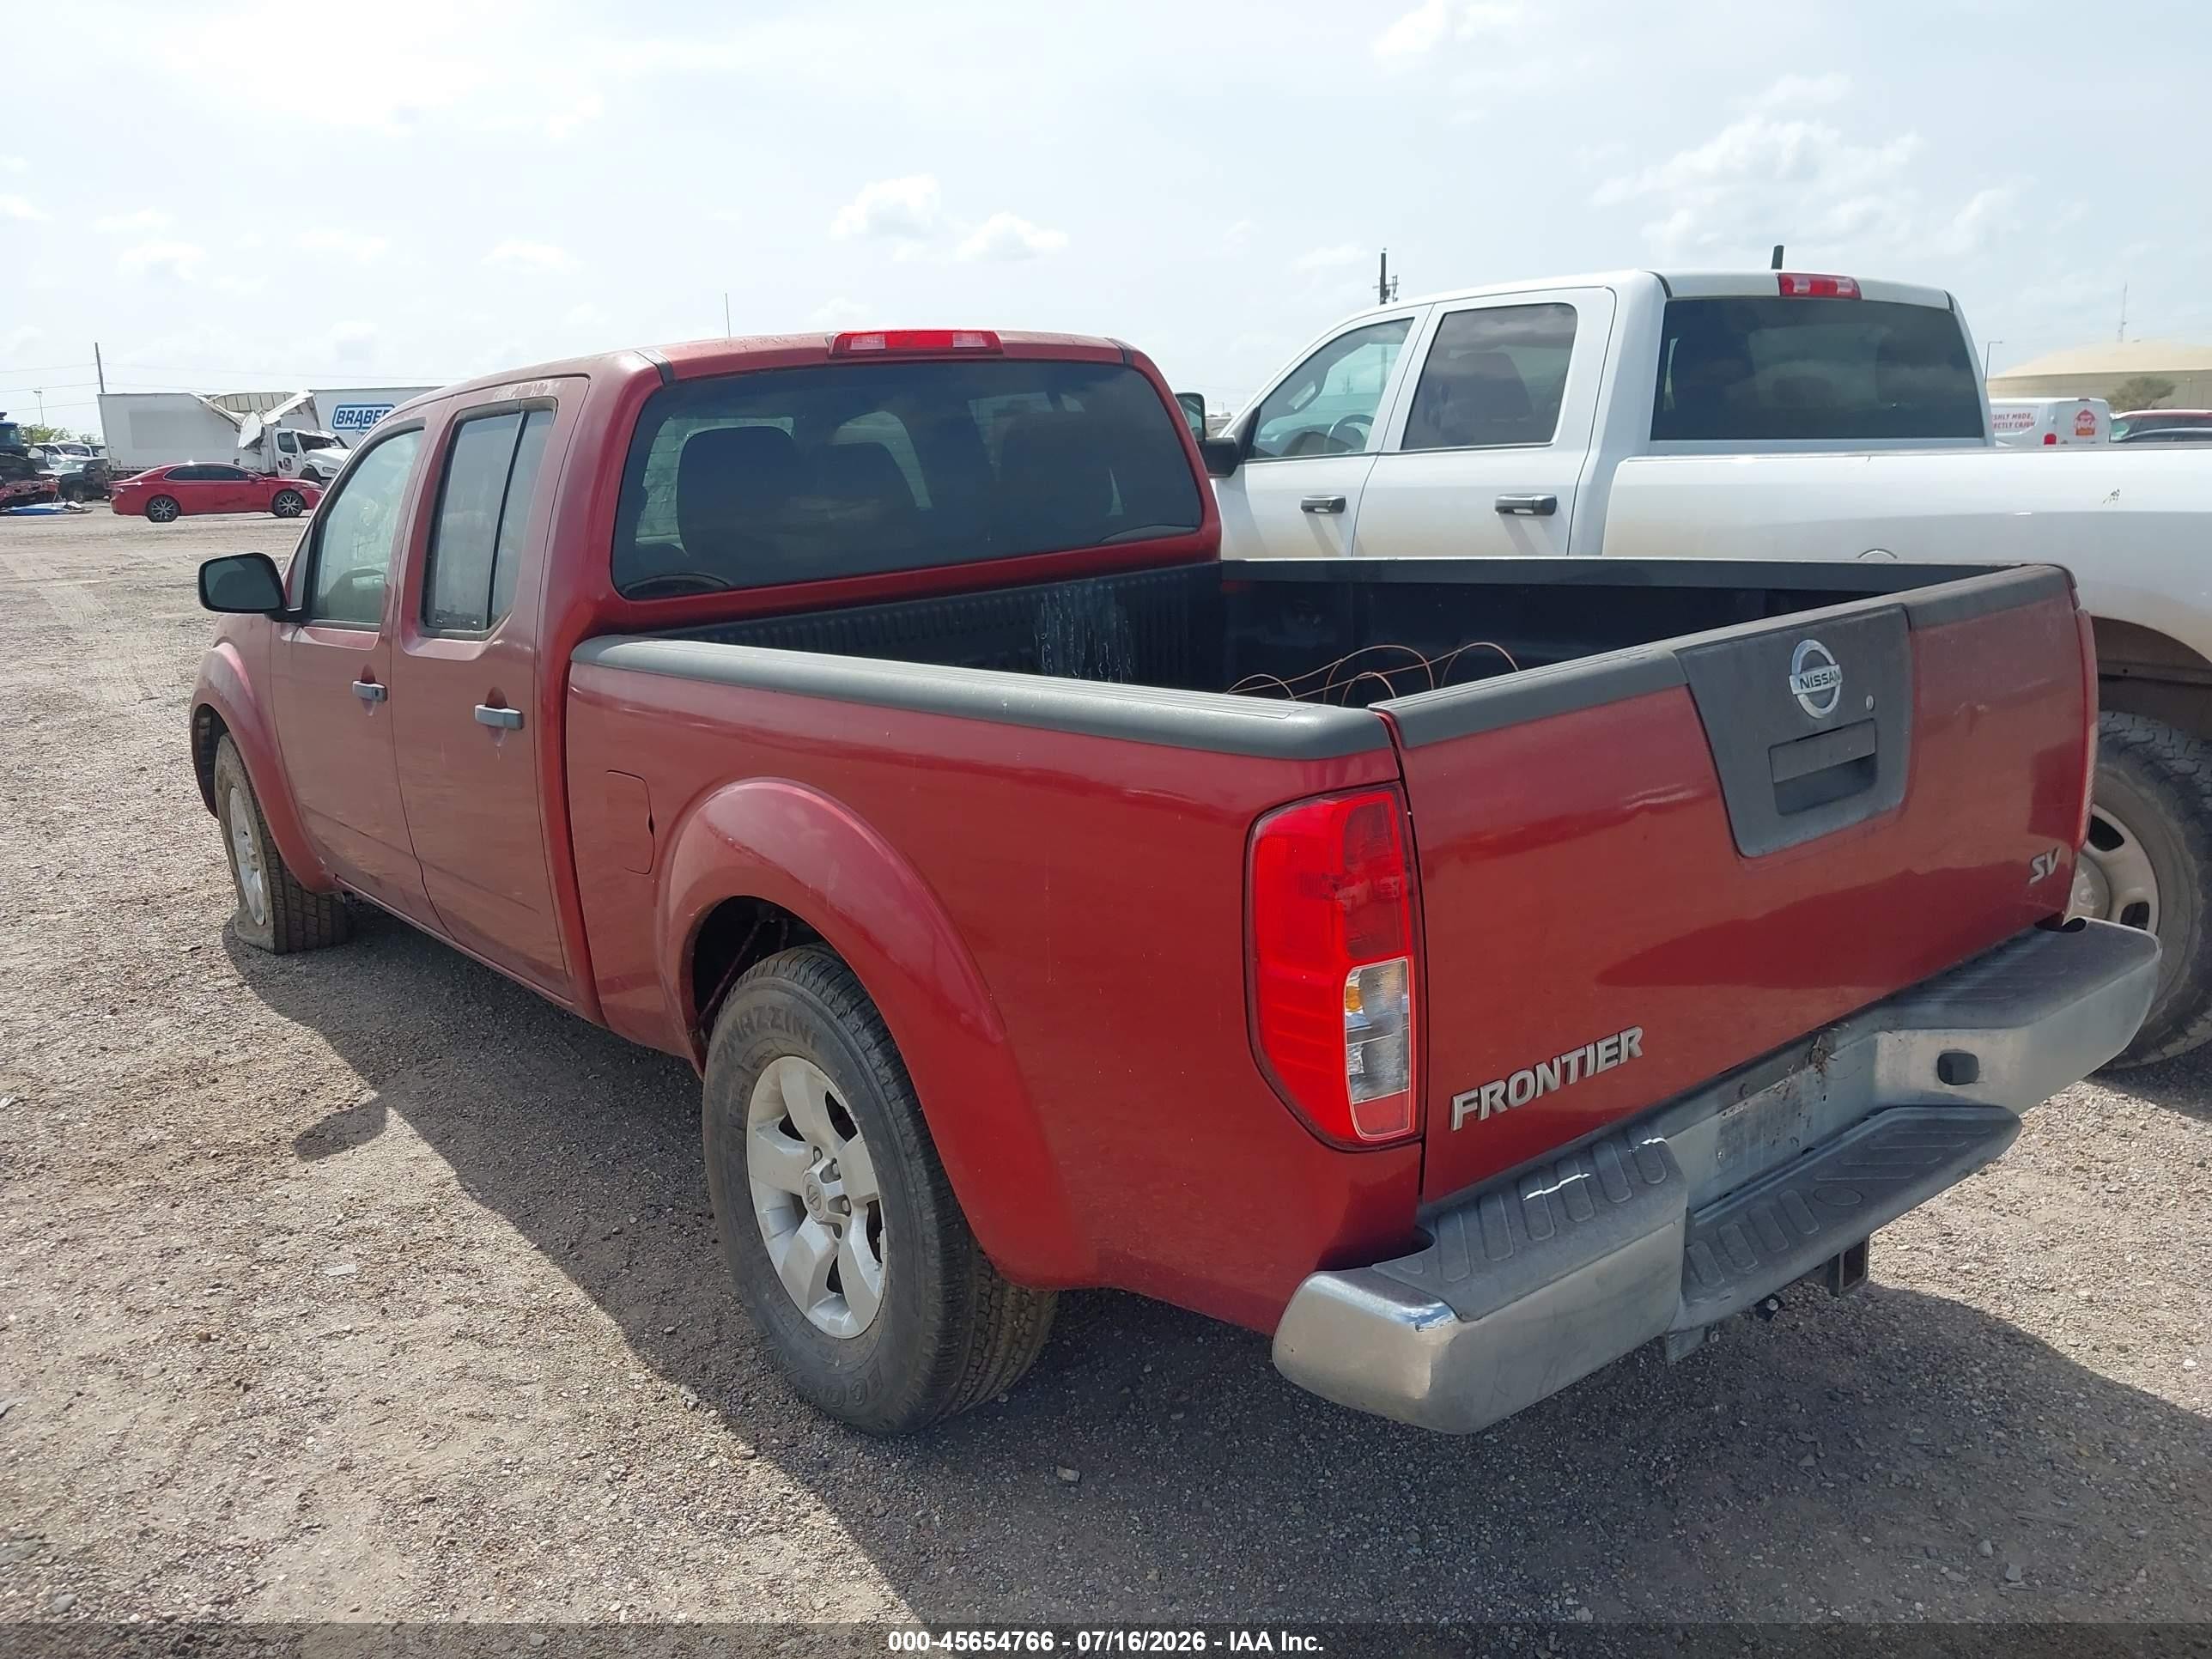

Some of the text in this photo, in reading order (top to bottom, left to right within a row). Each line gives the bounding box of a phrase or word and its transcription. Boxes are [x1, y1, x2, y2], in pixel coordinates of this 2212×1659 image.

[1799, 670, 1840, 690] NISSAN
[2029, 846, 2061, 884] SV
[1450, 1025, 1644, 1132] FRONTIER
